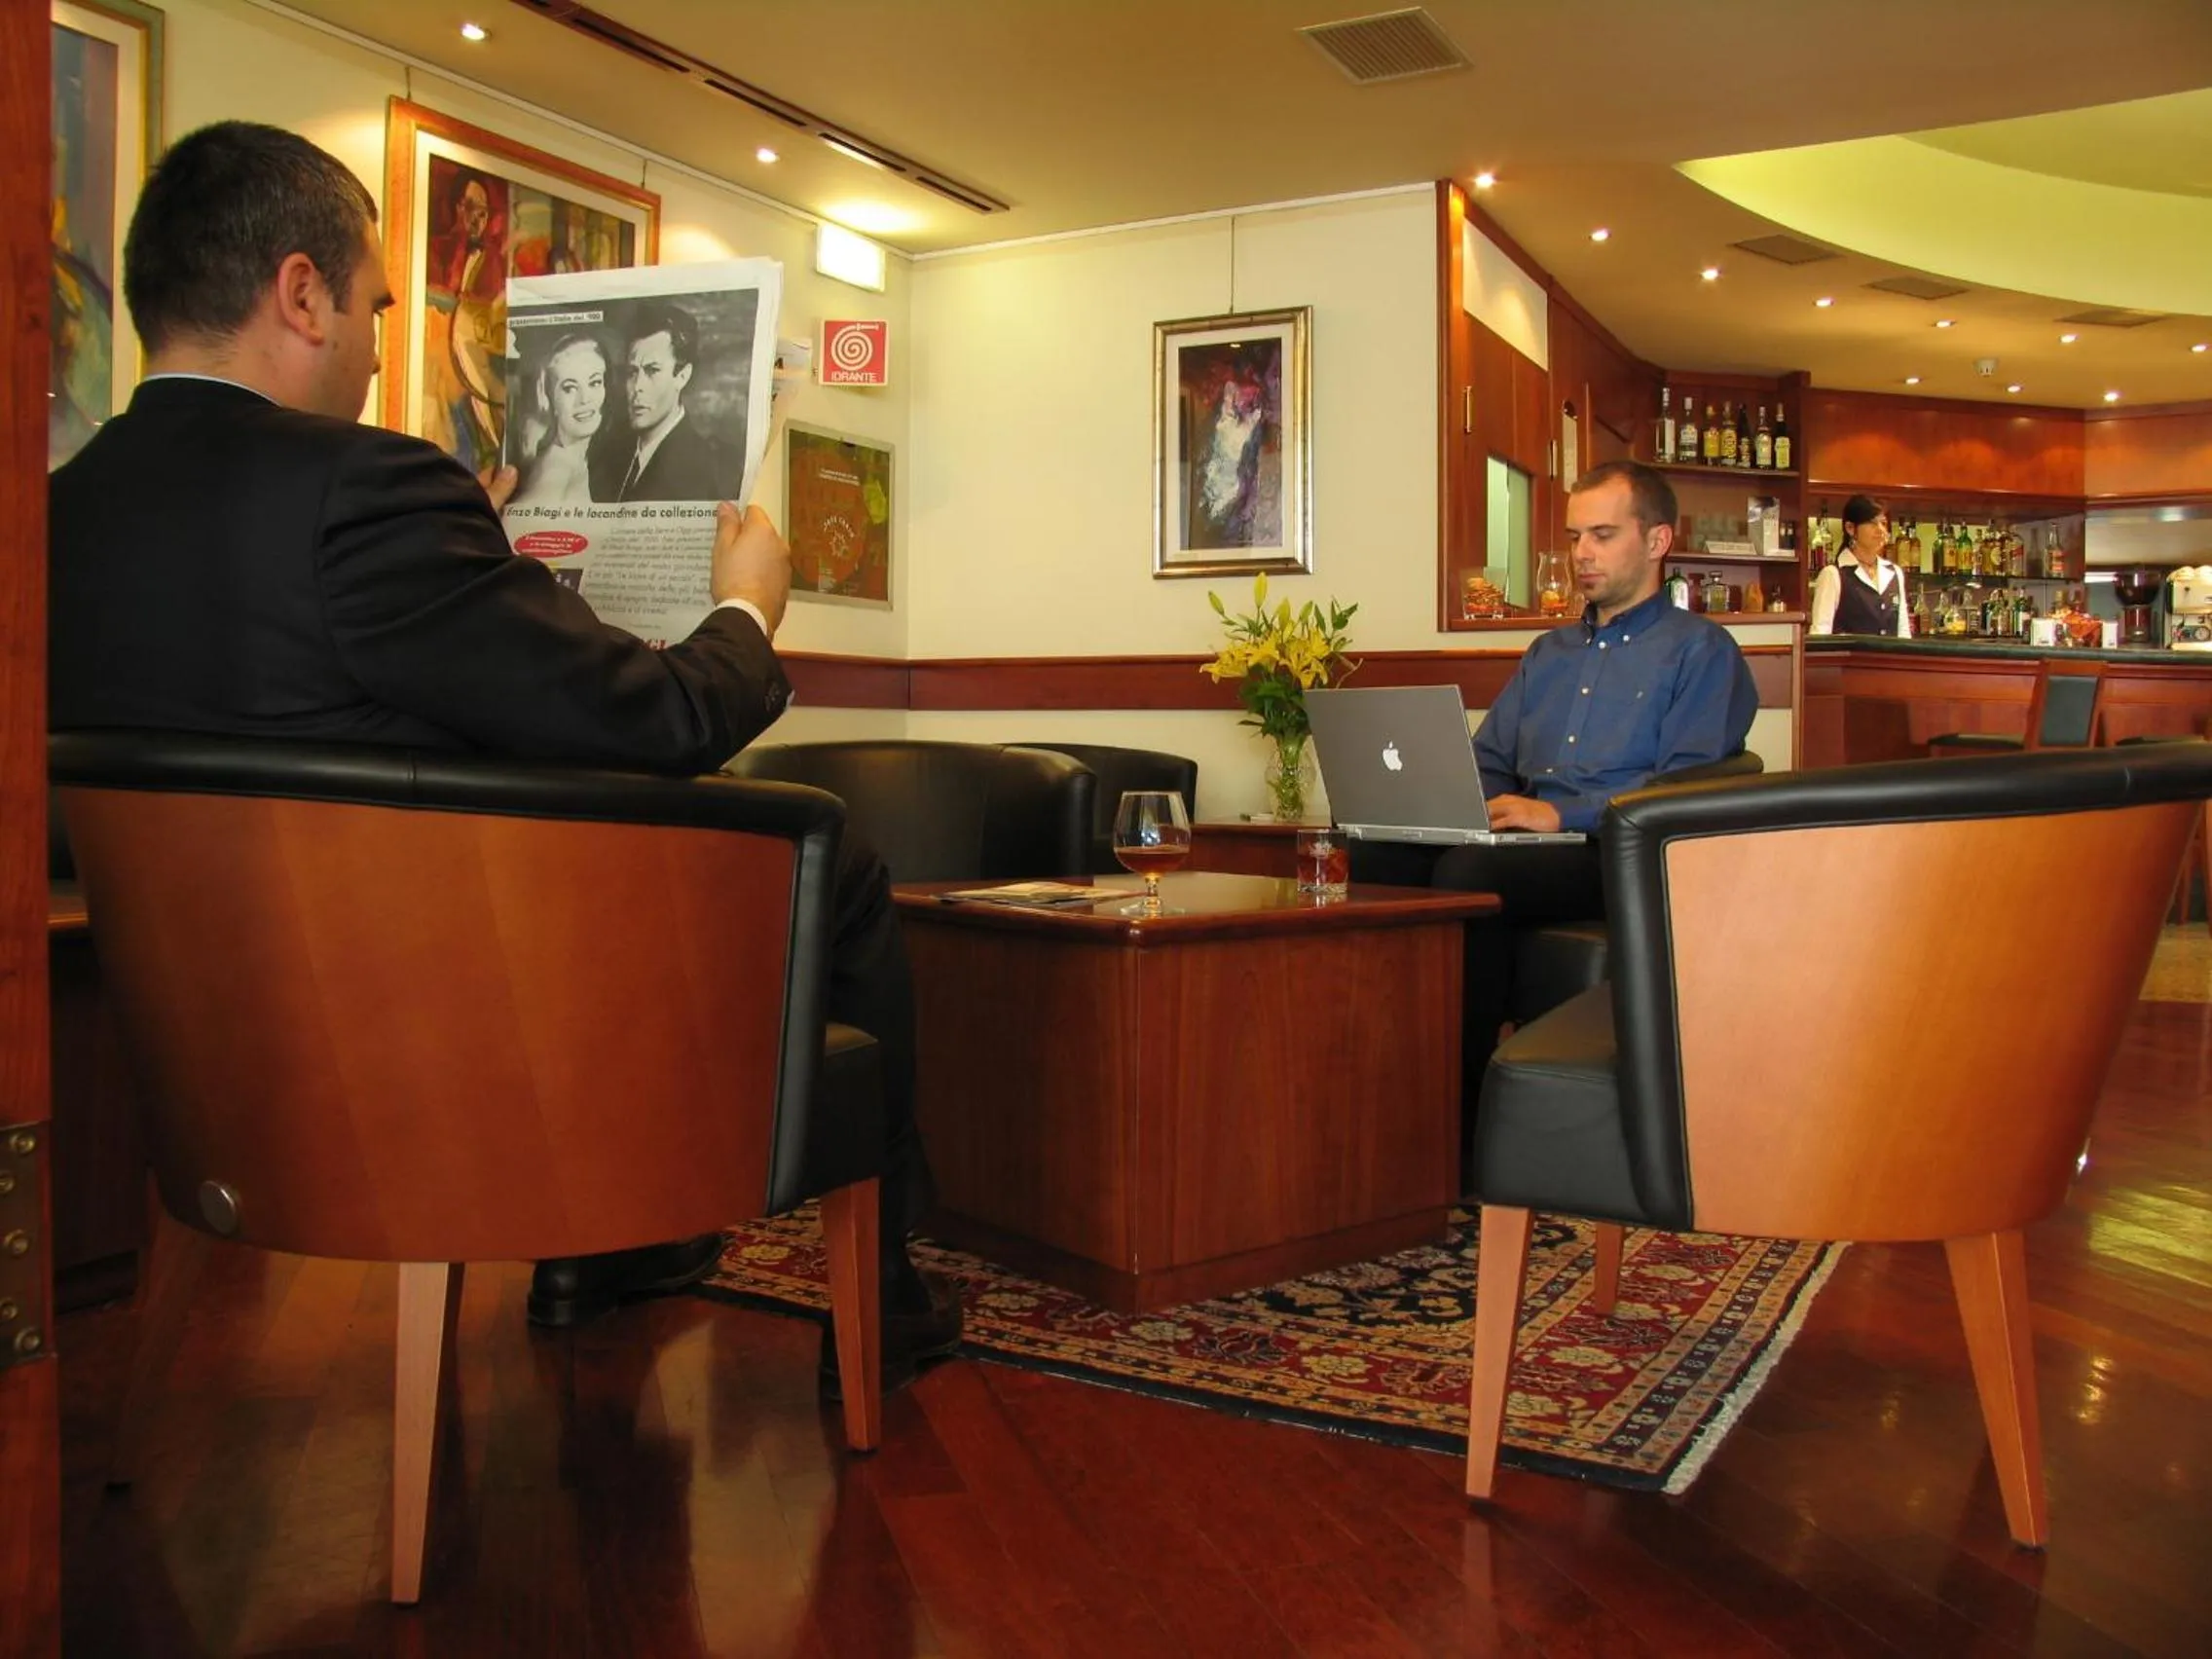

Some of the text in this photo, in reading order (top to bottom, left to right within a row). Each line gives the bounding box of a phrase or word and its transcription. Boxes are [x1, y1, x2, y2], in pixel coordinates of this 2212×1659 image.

[830, 371, 877, 383] IDRANTE
[506, 506, 531, 517] Enzo
[533, 505, 562, 520] Biagi
[564, 509, 571, 518] e
[573, 506, 583, 518] le
[641, 506, 656, 518] da
[660, 505, 719, 518] collezione
